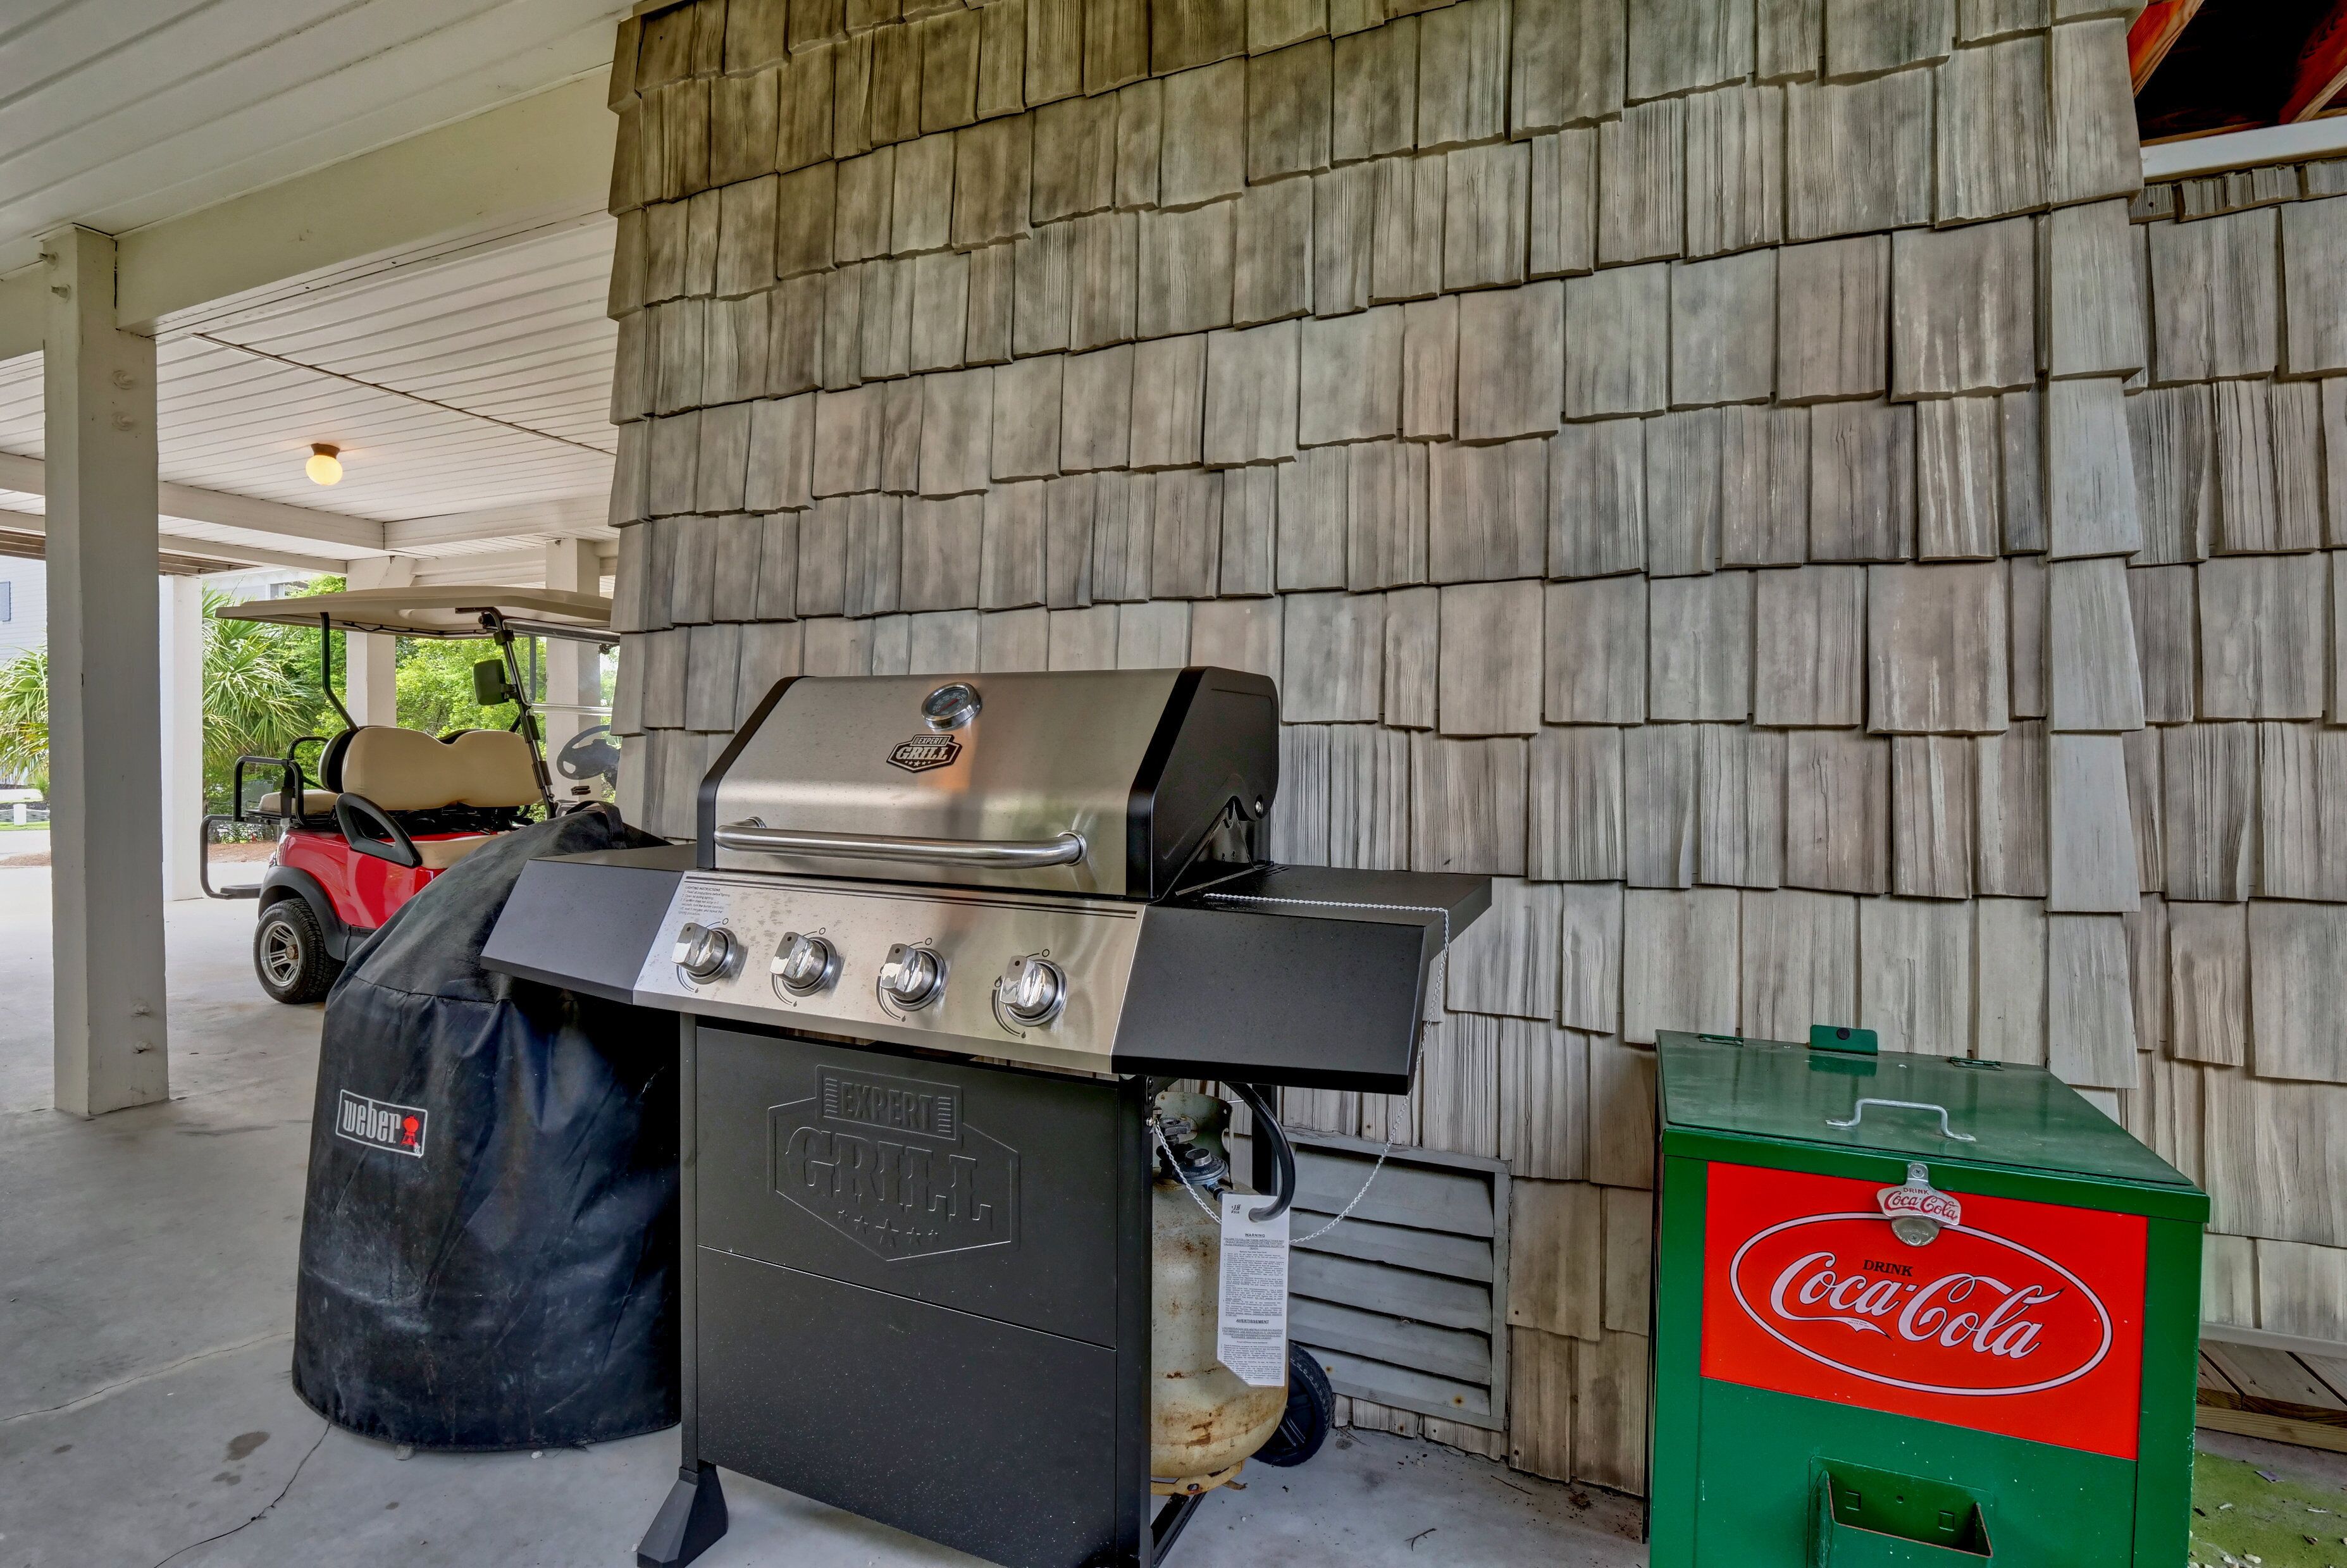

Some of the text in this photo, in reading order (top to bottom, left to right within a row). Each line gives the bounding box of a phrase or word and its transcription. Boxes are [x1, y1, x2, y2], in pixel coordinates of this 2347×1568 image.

[895, 746, 949, 760] GRILL
[342, 1098, 401, 1144] weber
[842, 1082, 932, 1130] EXPERT
[785, 1127, 993, 1231] GRILL
[1862, 1259, 1914, 1277] DRINK
[1769, 1250, 2067, 1359] Coca-Cola
